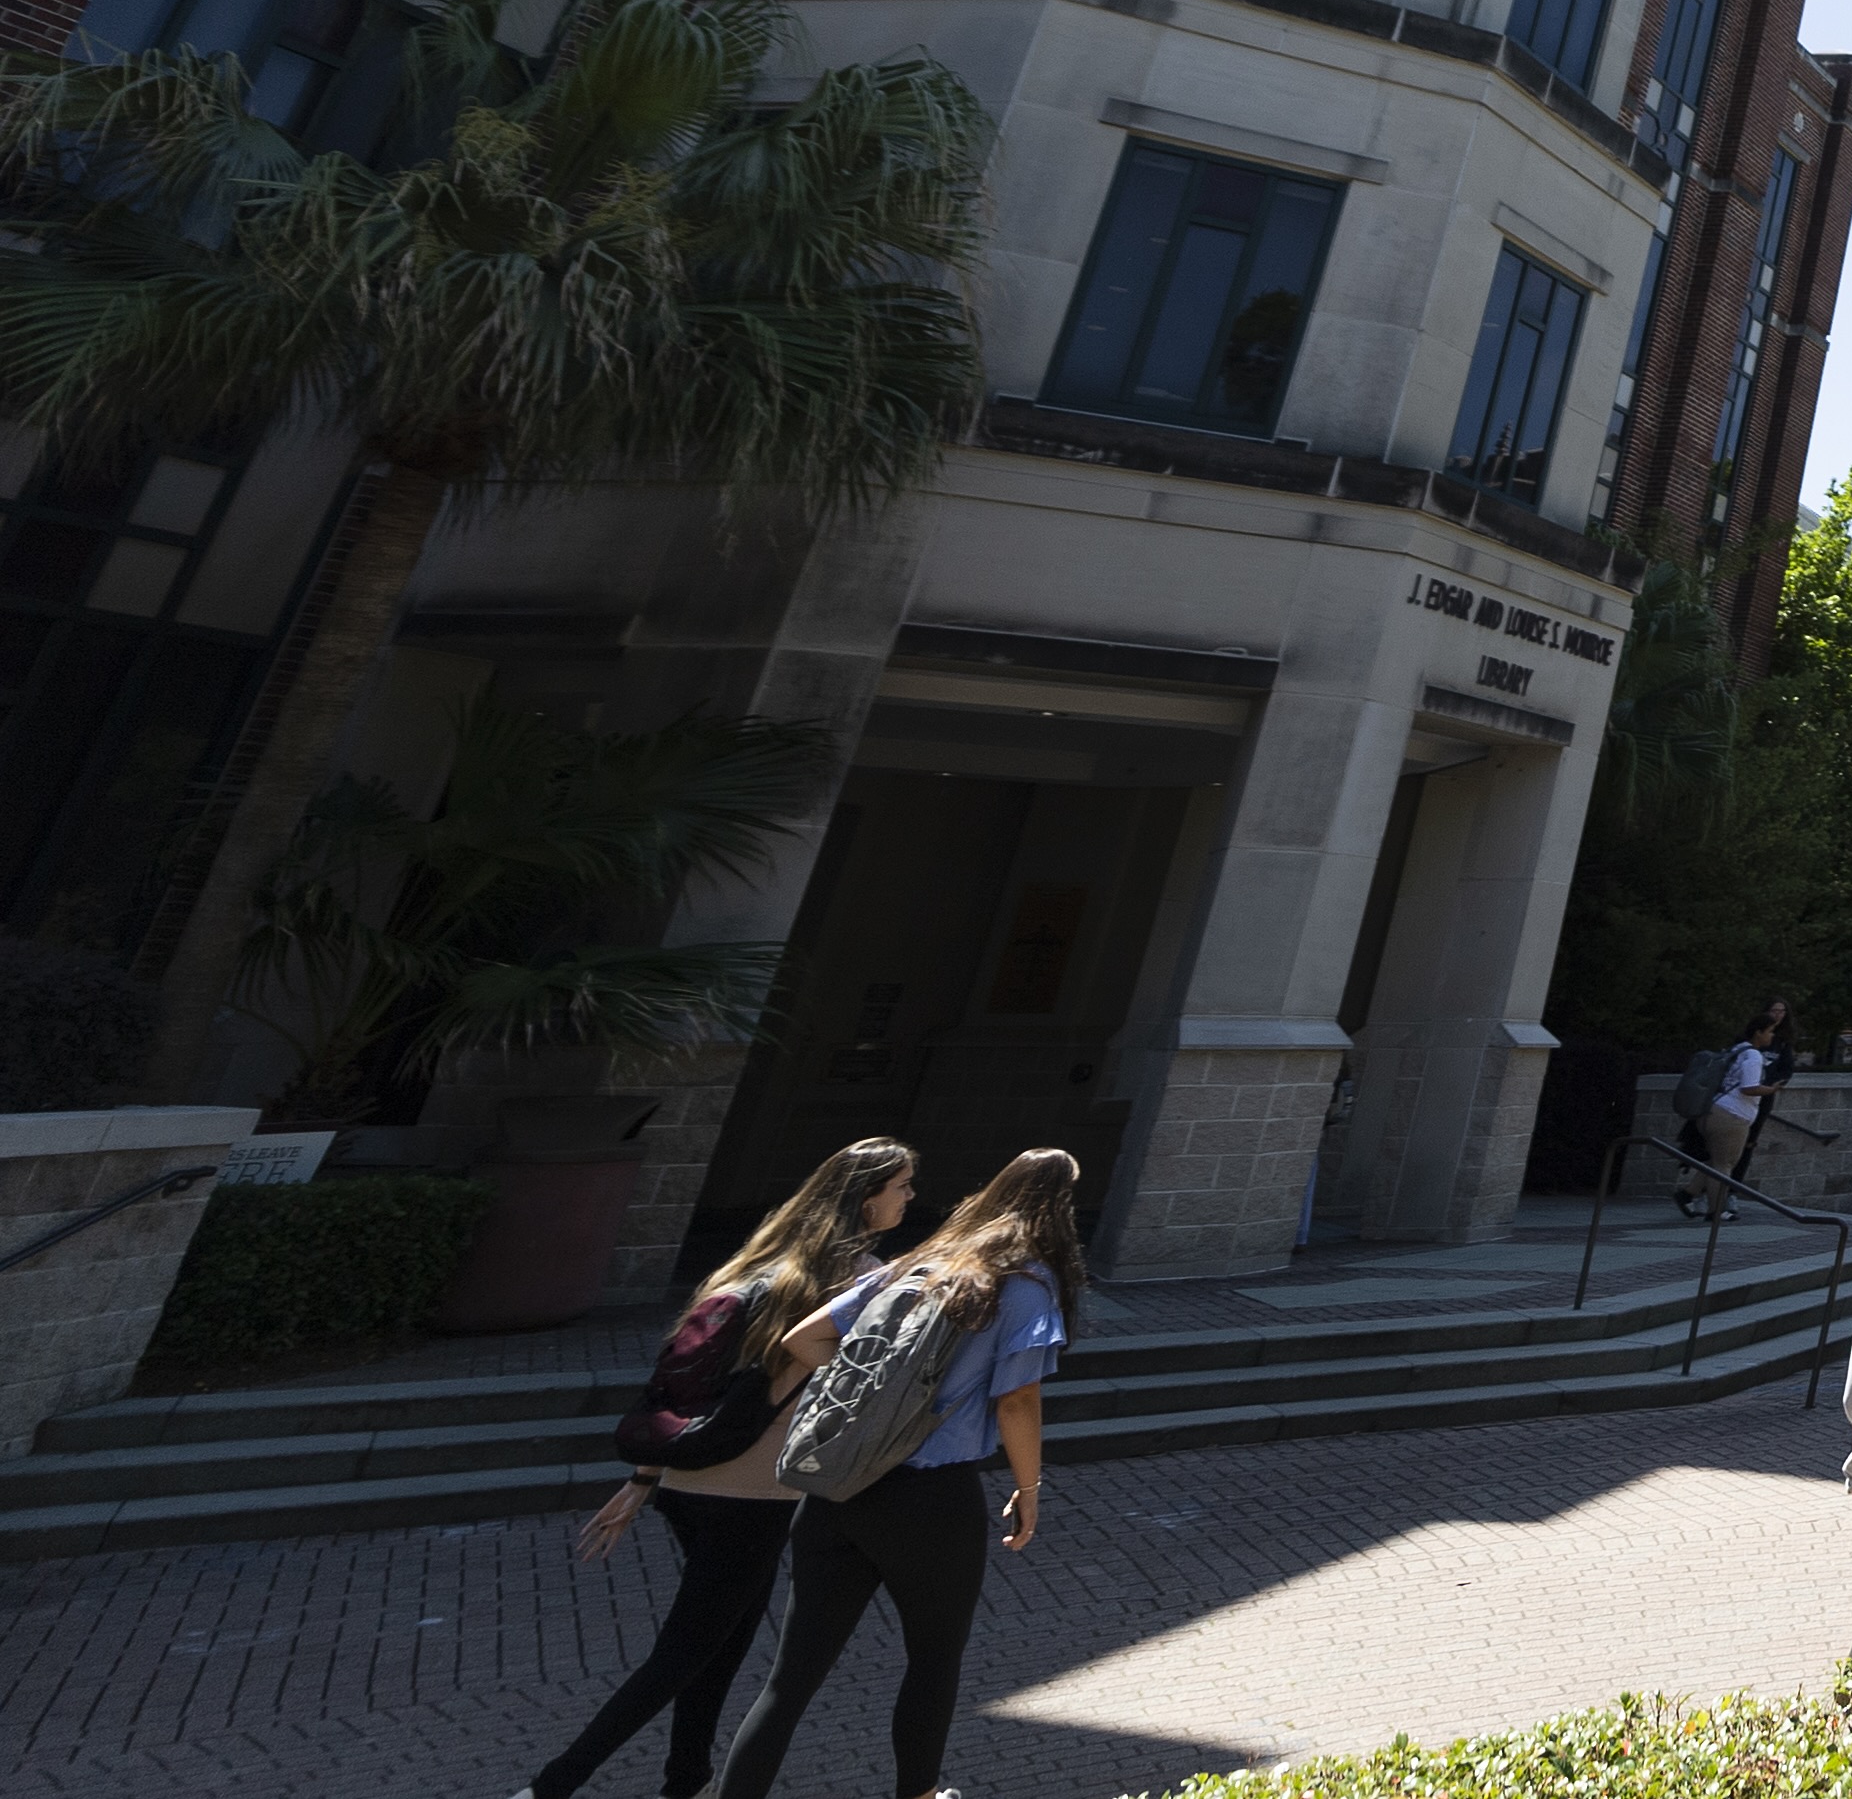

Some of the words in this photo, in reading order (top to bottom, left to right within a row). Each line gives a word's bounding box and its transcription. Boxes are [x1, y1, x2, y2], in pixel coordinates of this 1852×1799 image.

[1407, 573, 1422, 605] J.
[1424, 578, 1473, 621] EDGAR
[1473, 596, 1504, 630] AND
[1504, 606, 1551, 645] LOUISE
[1476, 654, 1535, 697] LIBRARY
[245, 1146, 304, 1160] LEAVE
